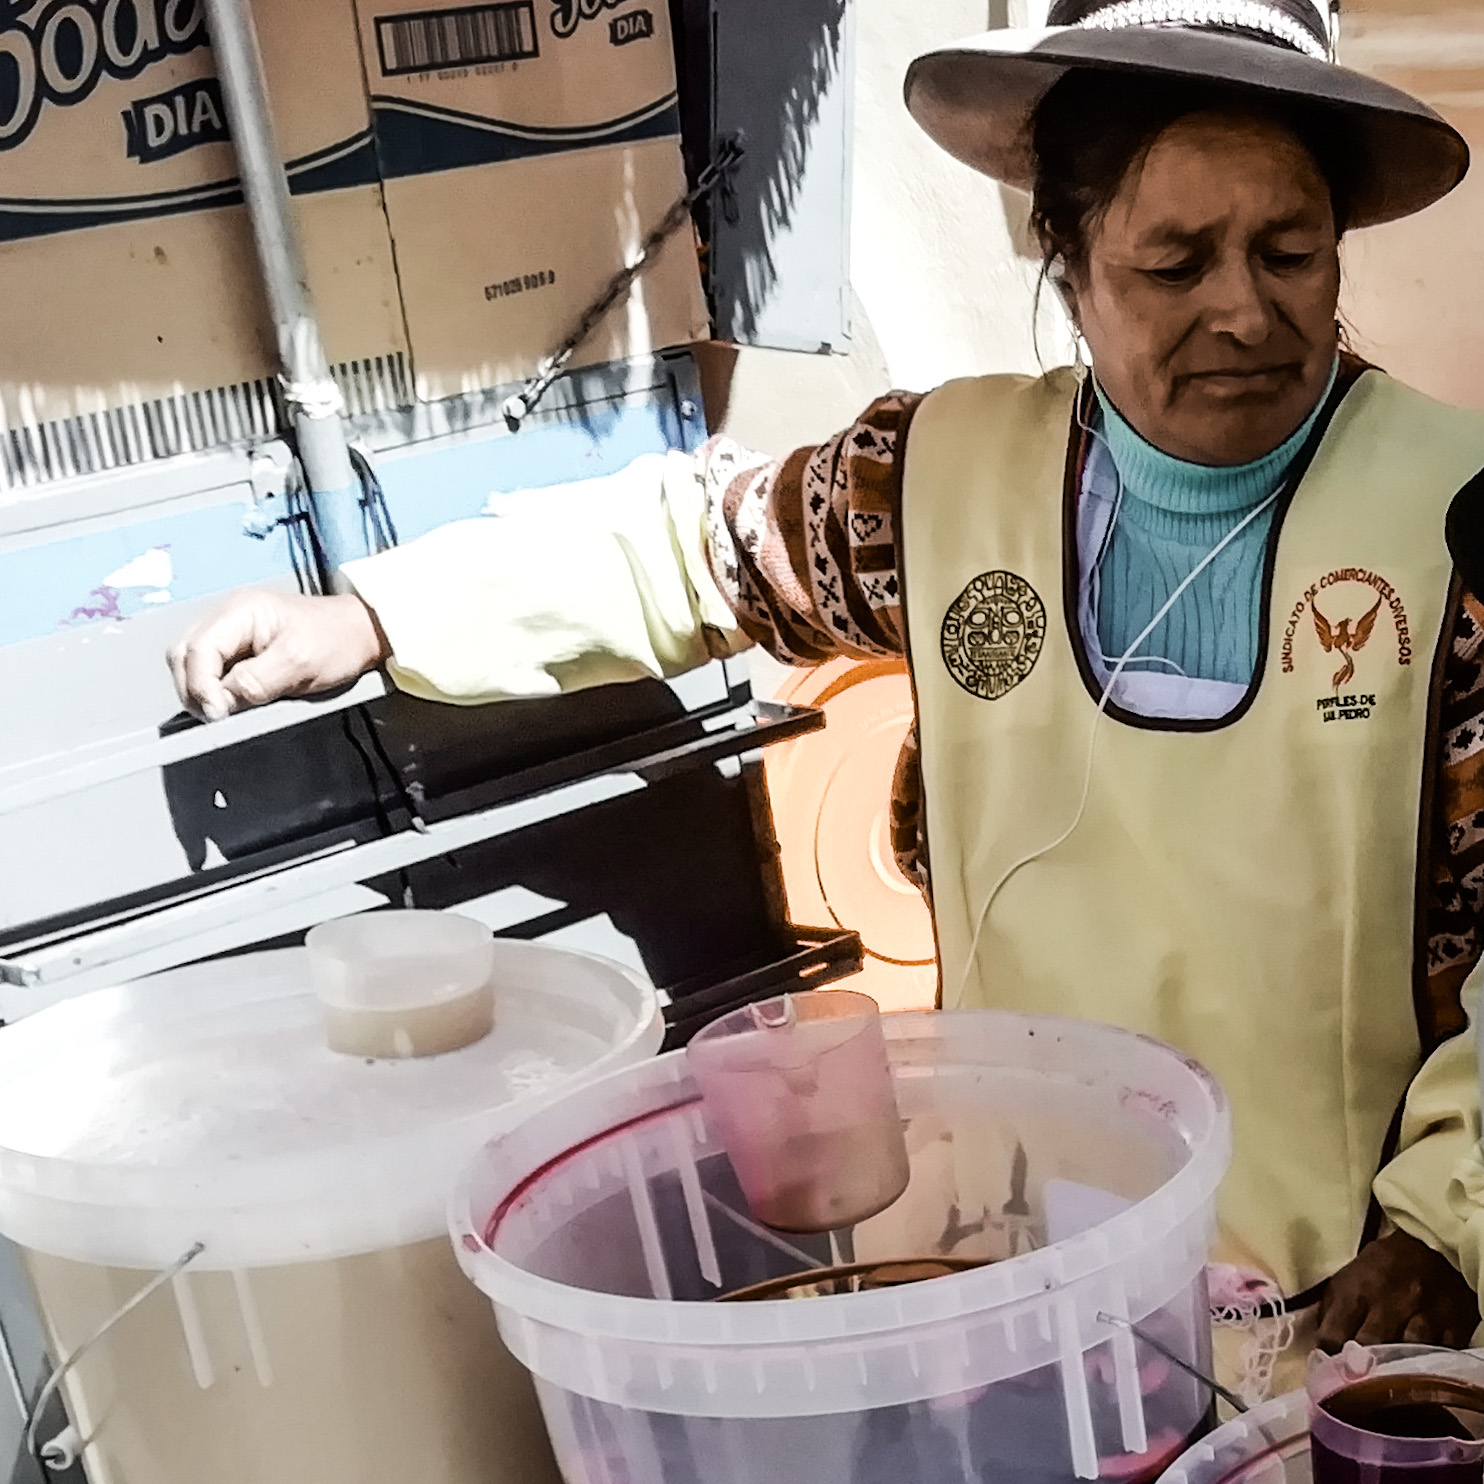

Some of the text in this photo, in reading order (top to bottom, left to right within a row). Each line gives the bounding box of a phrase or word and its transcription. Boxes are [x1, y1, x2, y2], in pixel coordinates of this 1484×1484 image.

[616, 15, 647, 39] DIA
[144, 90, 222, 148] DIA
[1281, 568, 1412, 674] SINDICATO DE COMERCIANTES DIVERSOS
[1360, 694, 1377, 706] DE
